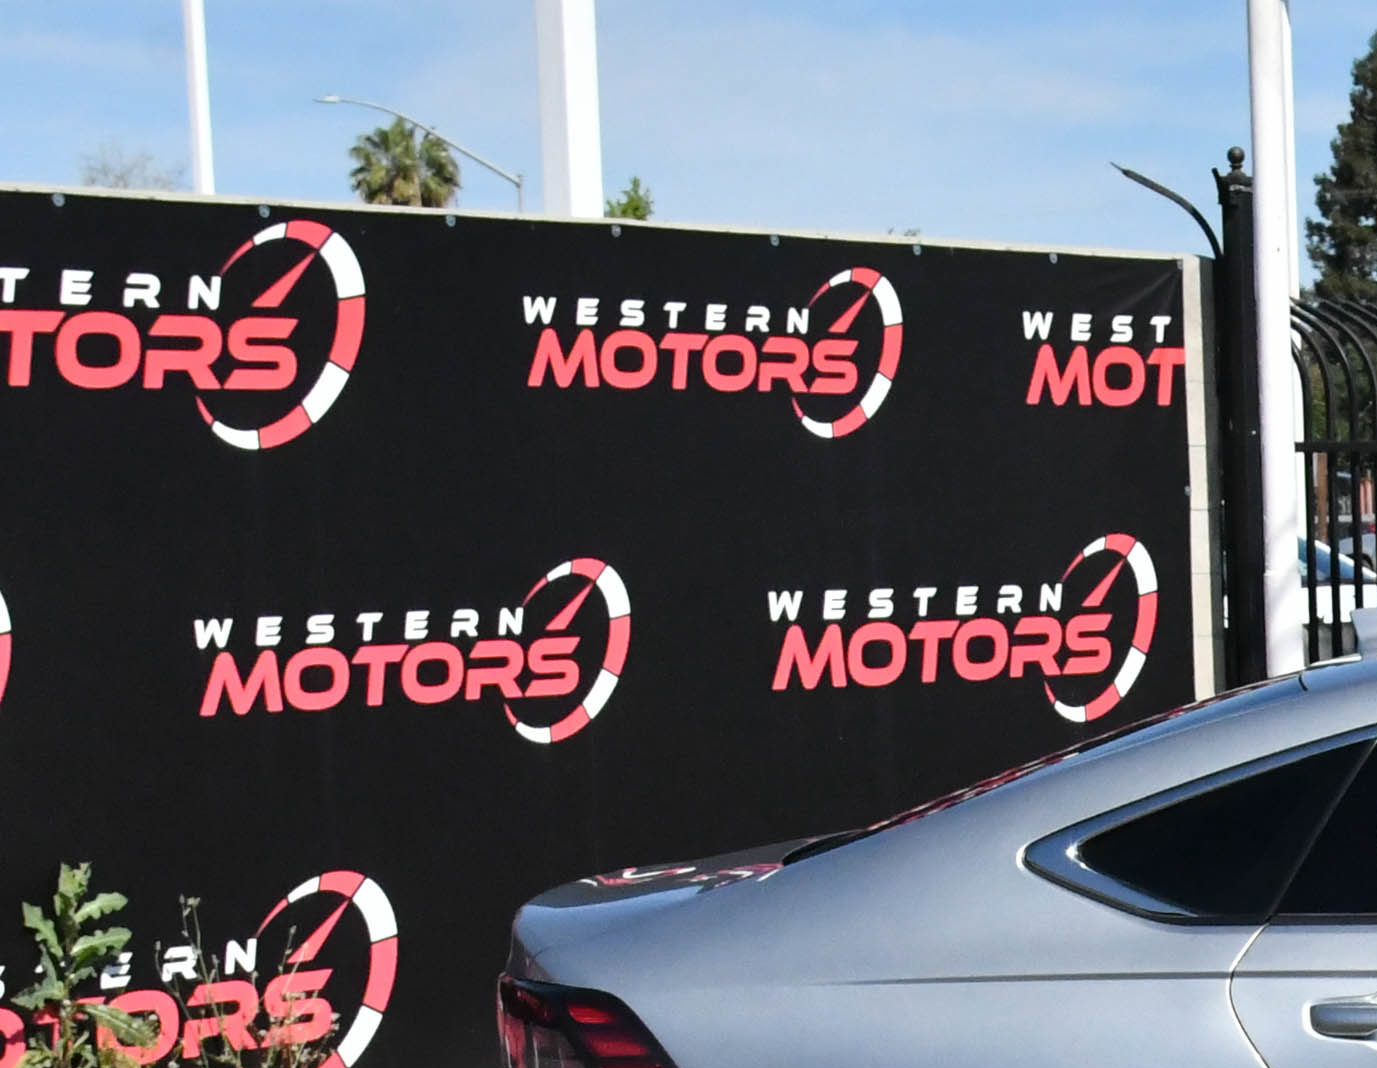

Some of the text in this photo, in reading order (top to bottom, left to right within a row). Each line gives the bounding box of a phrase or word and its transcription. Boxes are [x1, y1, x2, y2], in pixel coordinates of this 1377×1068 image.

[0, 267, 222, 311] TERN
[522, 295, 810, 335] WESTERN
[0, 309, 299, 391] TORS
[1022, 310, 1172, 344] WEST
[527, 327, 860, 396] MOTORS
[1026, 343, 1186, 407] MOT
[193, 606, 525, 650] WESTERN
[767, 582, 1063, 622] WESTERN
[199, 636, 581, 717] MOTORS
[771, 612, 1114, 691] MOTORS
